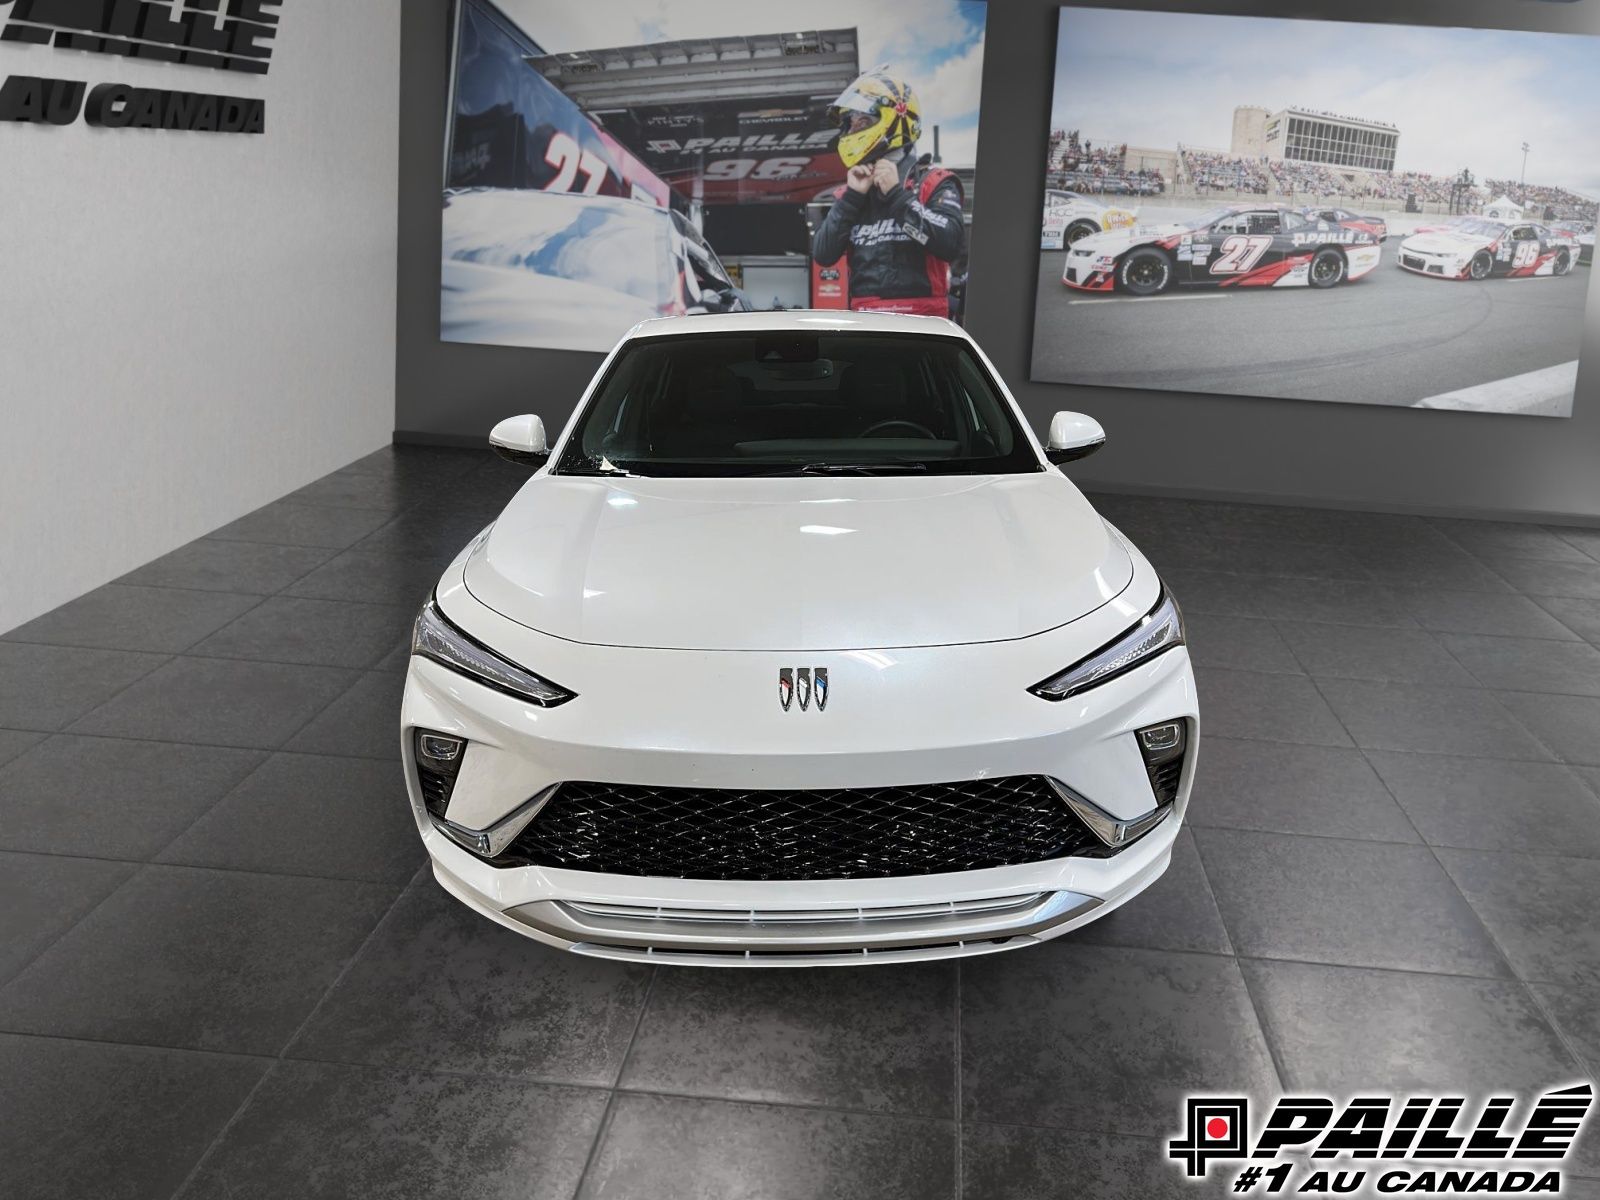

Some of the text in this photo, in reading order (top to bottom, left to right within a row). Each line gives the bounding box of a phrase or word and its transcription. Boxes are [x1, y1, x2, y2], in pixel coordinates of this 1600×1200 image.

[0, 75, 265, 134] AU CANADA
[544, 130, 609, 194] 27
[743, 143, 828, 153] CANADA
[703, 156, 812, 181] 96
[1209, 234, 1274, 275] 27
[1512, 240, 1540, 268] 96
